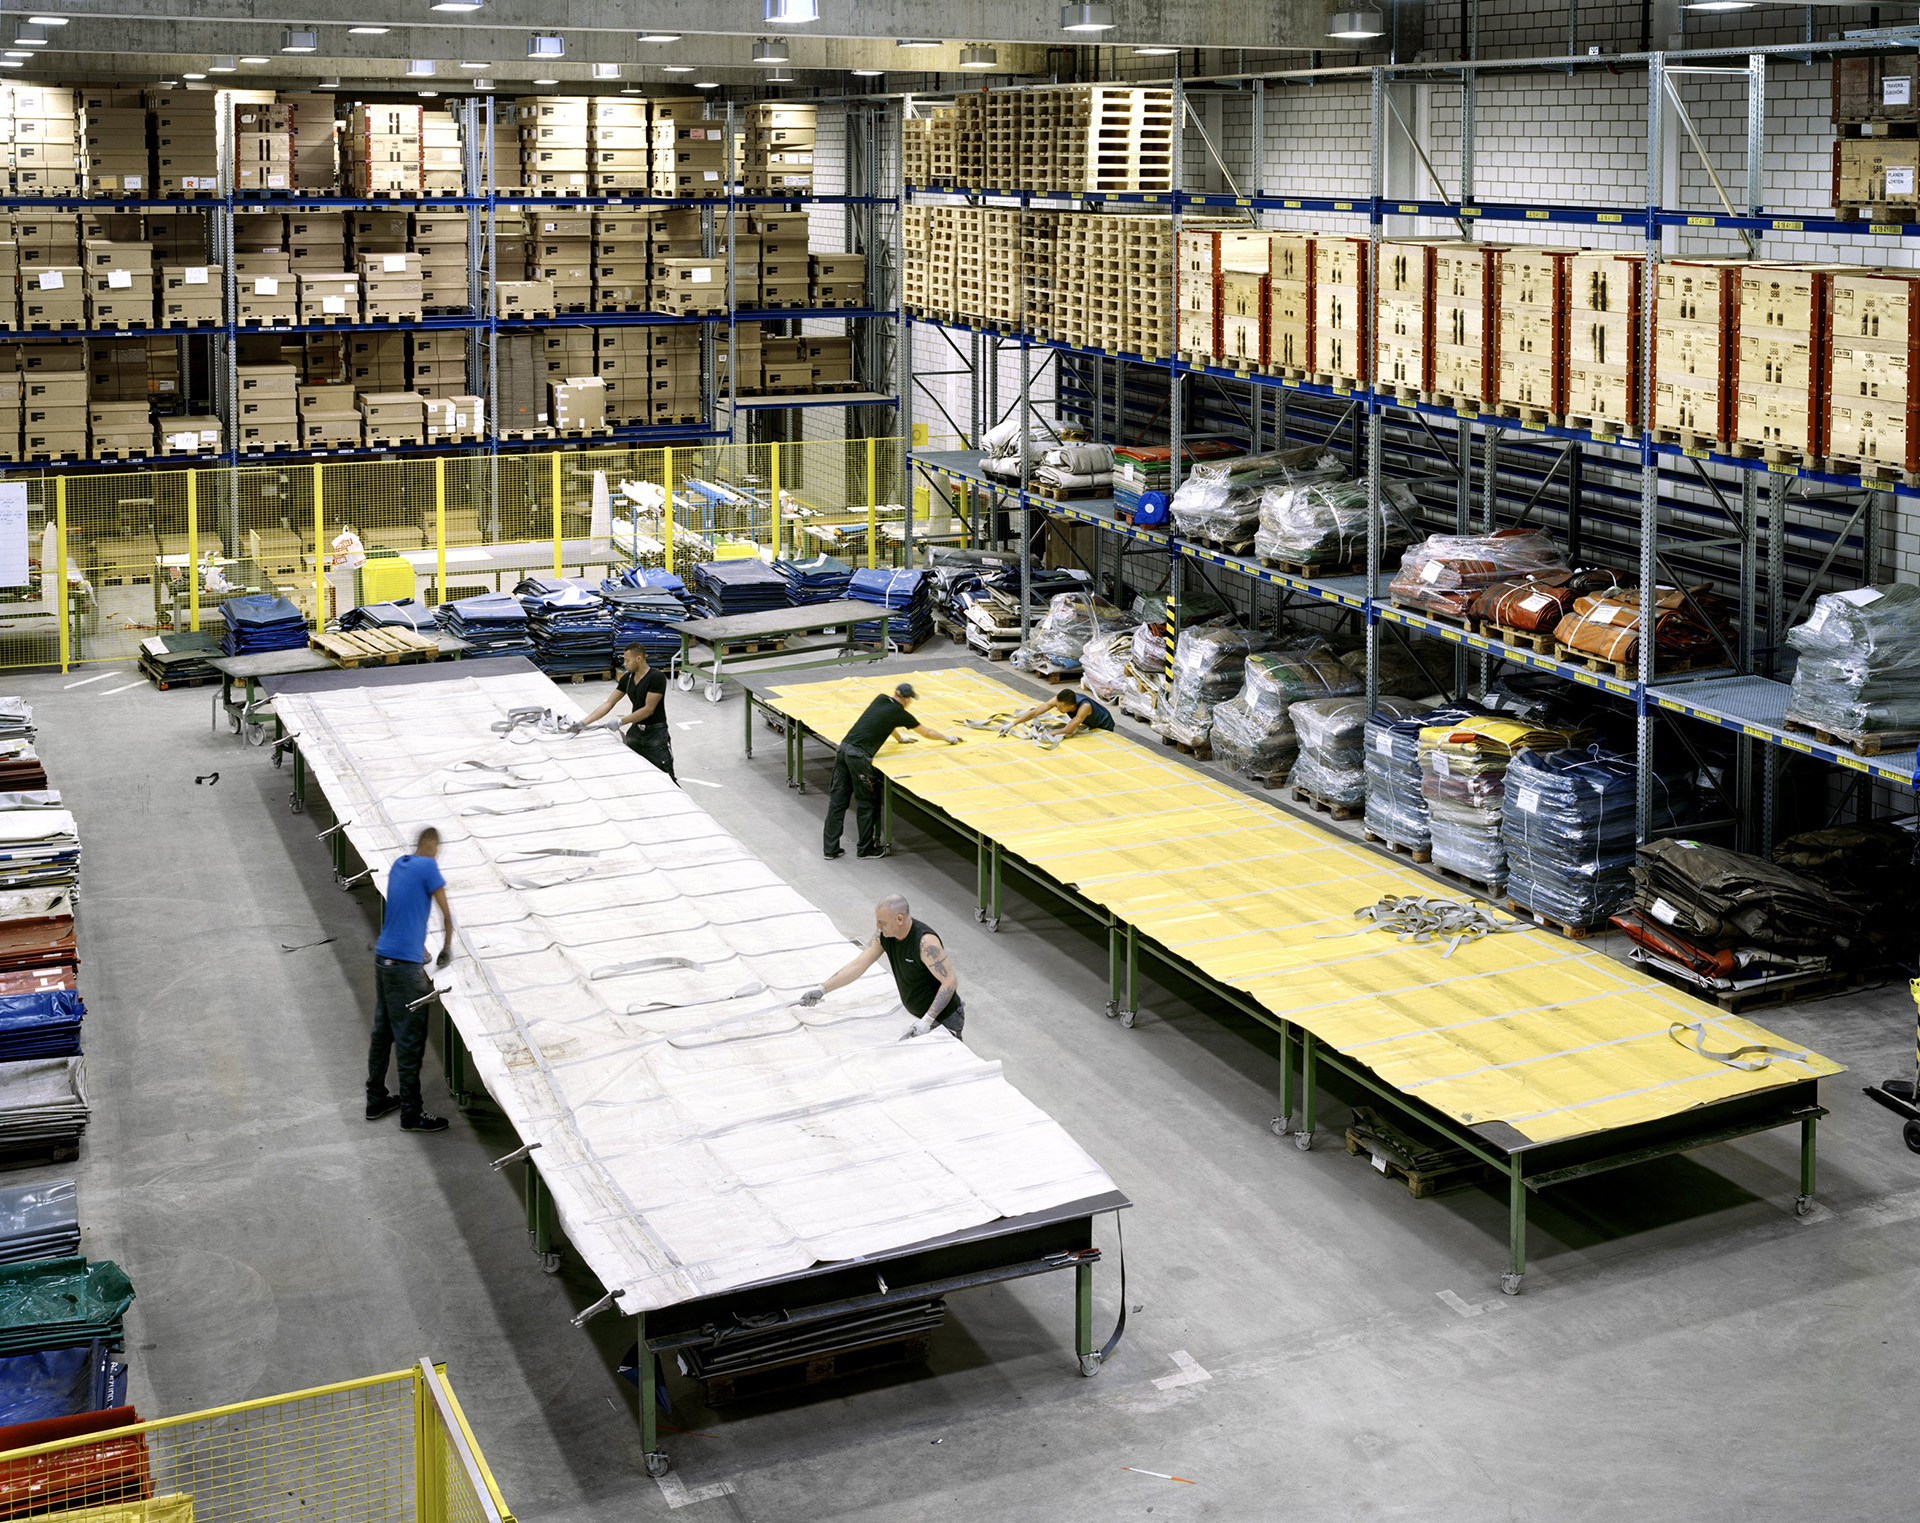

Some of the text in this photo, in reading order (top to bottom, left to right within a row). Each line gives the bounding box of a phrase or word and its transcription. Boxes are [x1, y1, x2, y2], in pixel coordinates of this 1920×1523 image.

[542, 107, 553, 115] F
[661, 109, 671, 117] F
[21, 124, 34, 132] F
[542, 129, 553, 137] F
[21, 149, 34, 157] F
[541, 153, 552, 161] F
[678, 154, 690, 162] F
[23, 173, 36, 182] F
[542, 175, 553, 183] F
[603, 176, 614, 184] F
[680, 177, 691, 185] F
[772, 176, 782, 184] F
[23, 227, 36, 235] F
[89, 226, 102, 235] F
[153, 227, 166, 235] F
[294, 225, 307, 234] F
[360, 224, 371, 232] F
[420, 225, 432, 233] F
[605, 224, 615, 232] F
[656, 223, 667, 231] F
[767, 224, 778, 232] F
[295, 249, 307, 257] F
[418, 248, 430, 256] F
[546, 246, 558, 255] F
[603, 246, 614, 254] F
[658, 245, 669, 253] F
[767, 245, 778, 253] F
[25, 251, 39, 260] F
[97, 256, 110, 264] F
[545, 269, 556, 277] F
[602, 268, 613, 276] F
[681, 271, 692, 279] F
[767, 267, 778, 275] F
[169, 279, 182, 288] F
[602, 291, 613, 299] F
[766, 288, 777, 296] F
[1770, 290, 1780, 298] SBB
[422, 293, 433, 302] F
[506, 296, 518, 304] F
[680, 294, 691, 302] F
[29, 306, 42, 316] F
[98, 306, 112, 315] F
[169, 305, 182, 314] F
[312, 334, 324, 343] F
[656, 336, 667, 345] F
[418, 342, 430, 350] F
[548, 340, 560, 348] F
[604, 339, 615, 347] F
[356, 344, 368, 352] F
[810, 348, 820, 356] F
[94, 352, 107, 360] F
[28, 358, 41, 367] F
[549, 362, 560, 370] F
[604, 361, 614, 369] F
[656, 359, 667, 367] F
[356, 368, 368, 377] F
[419, 366, 430, 374] F
[96, 374, 109, 384] F
[244, 380, 256, 389] F
[656, 381, 667, 389] F
[32, 386, 45, 395] F
[304, 397, 316, 406] F
[244, 405, 257, 413] F
[656, 403, 667, 411] F
[31, 412, 45, 422] F
[246, 429, 258, 438] F
[310, 427, 322, 436] F
[31, 438, 45, 447] F
